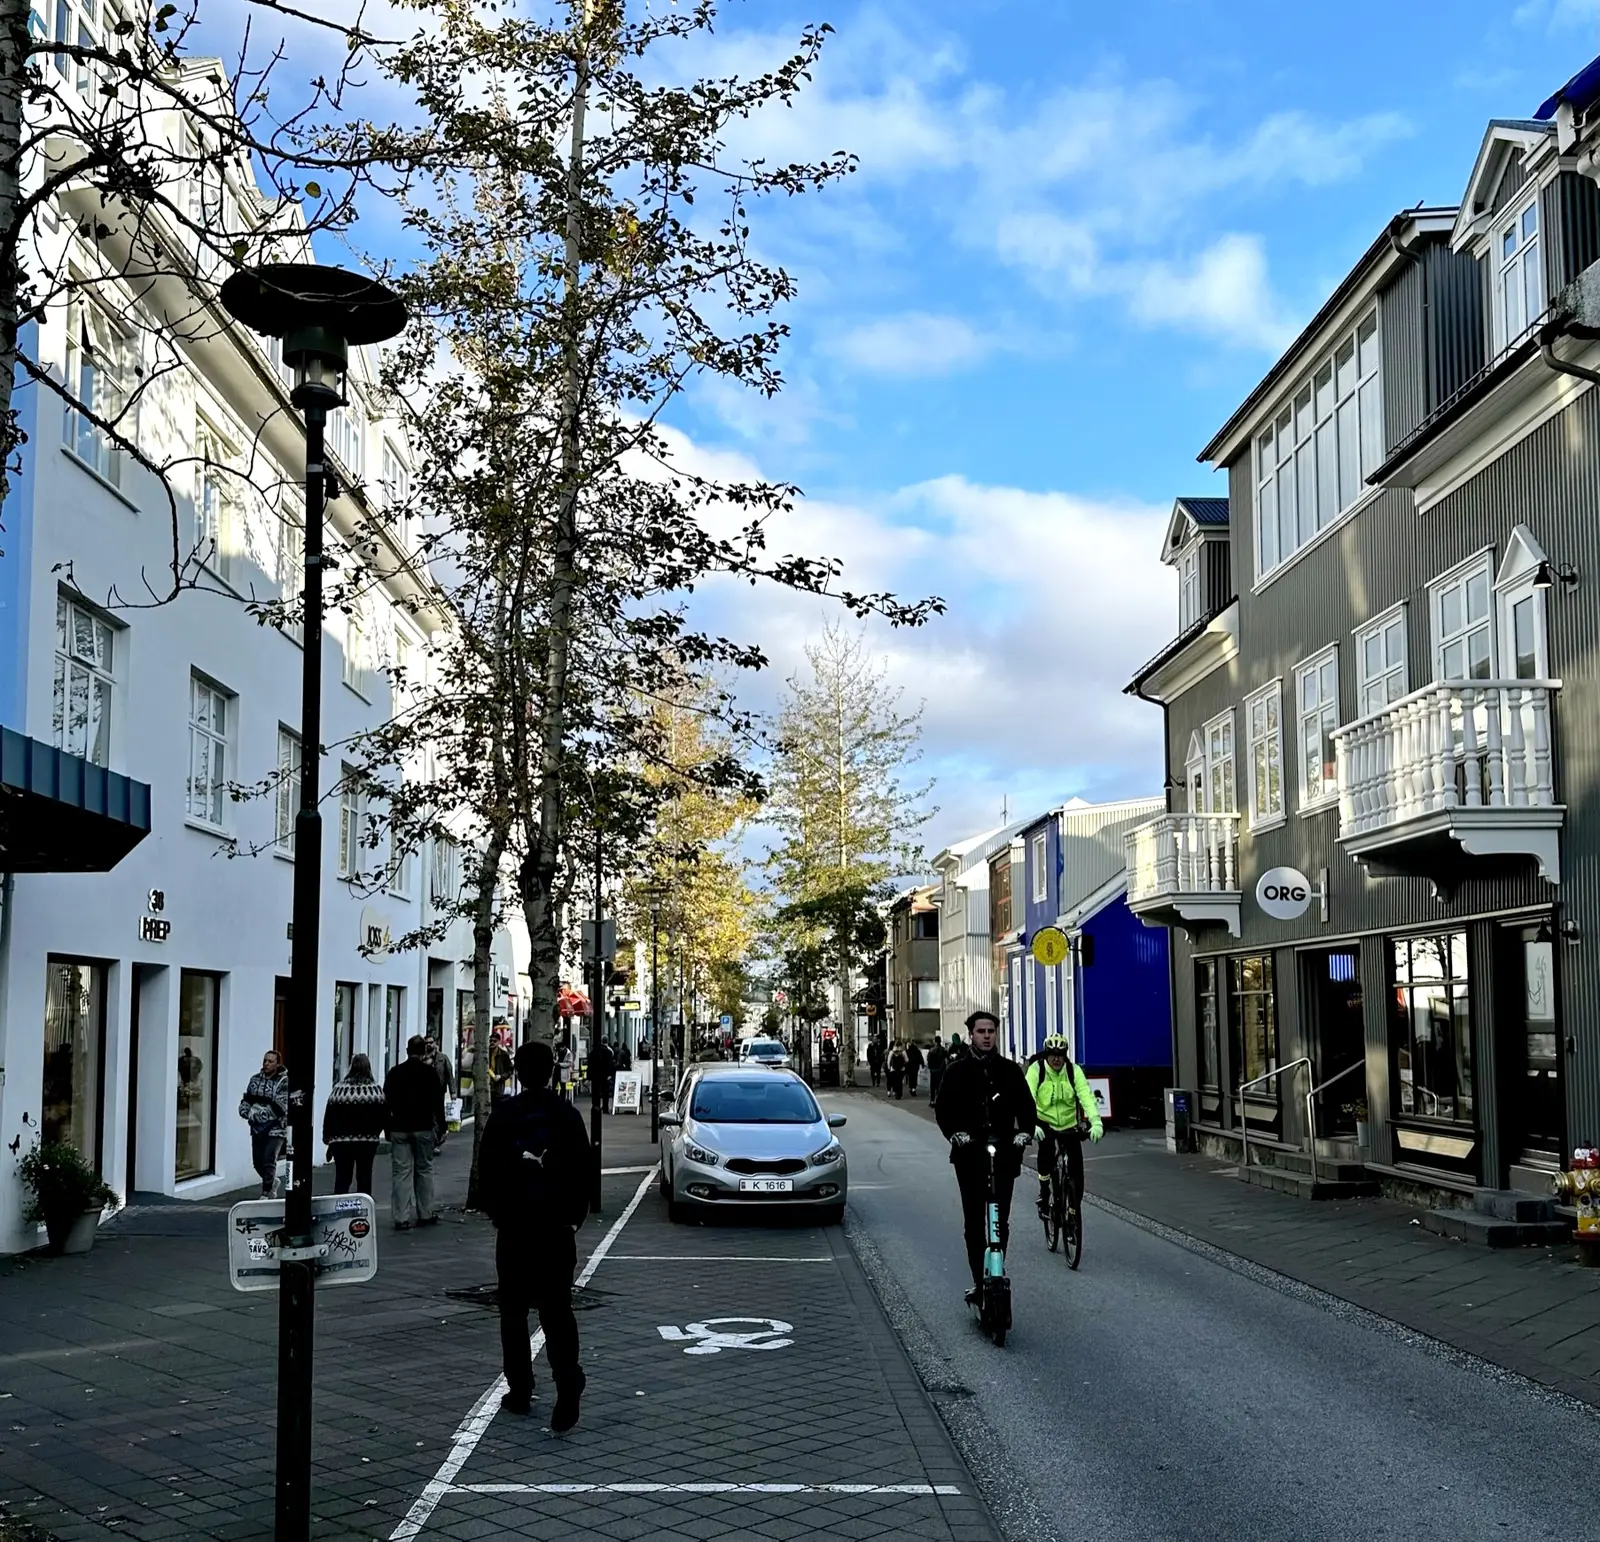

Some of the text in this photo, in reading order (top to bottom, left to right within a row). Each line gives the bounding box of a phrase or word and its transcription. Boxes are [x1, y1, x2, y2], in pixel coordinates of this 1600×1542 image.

[1263, 885, 1306, 901] ORG
[752, 1181, 786, 1190] K 1616
